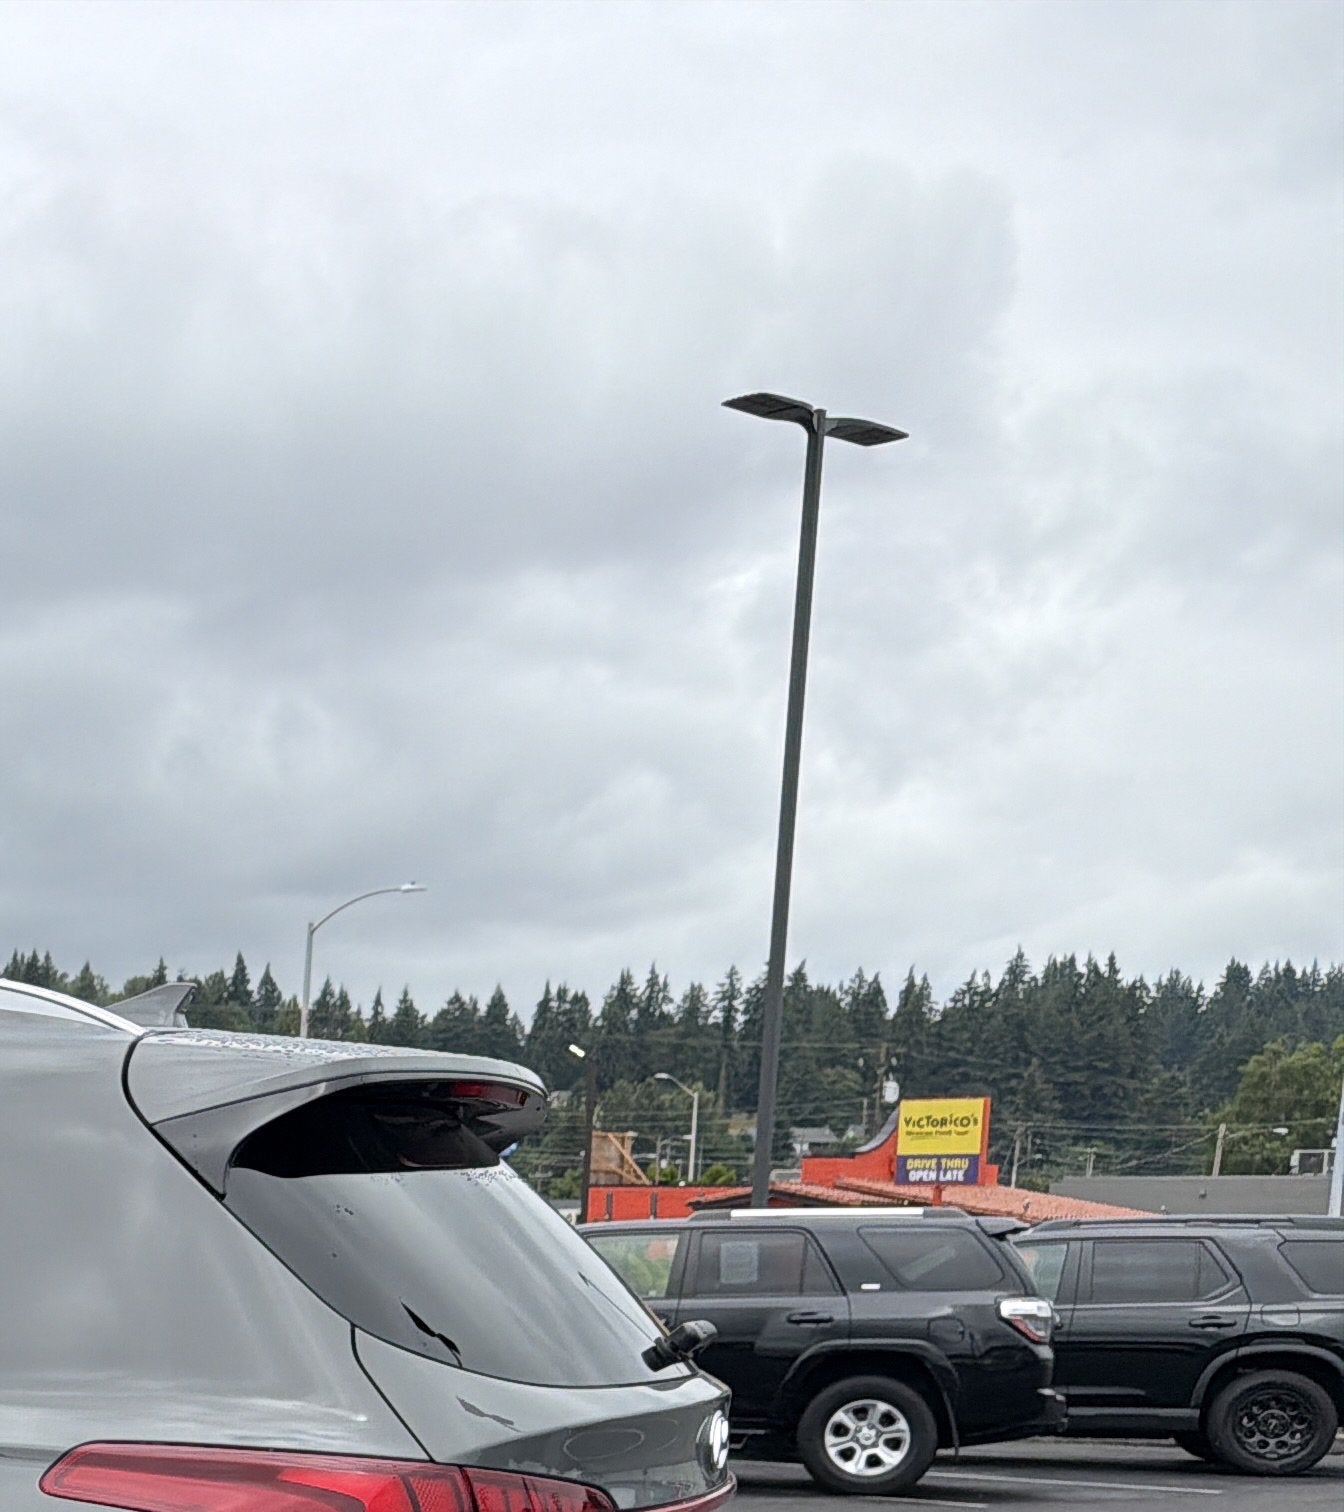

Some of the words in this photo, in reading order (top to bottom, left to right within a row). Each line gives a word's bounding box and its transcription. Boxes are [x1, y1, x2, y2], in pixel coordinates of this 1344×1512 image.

[906, 1158, 937, 1170] DRIVE
[941, 1158, 969, 1170] THRU
[908, 1170, 937, 1182] OPEN
[939, 1170, 965, 1182] LATE
